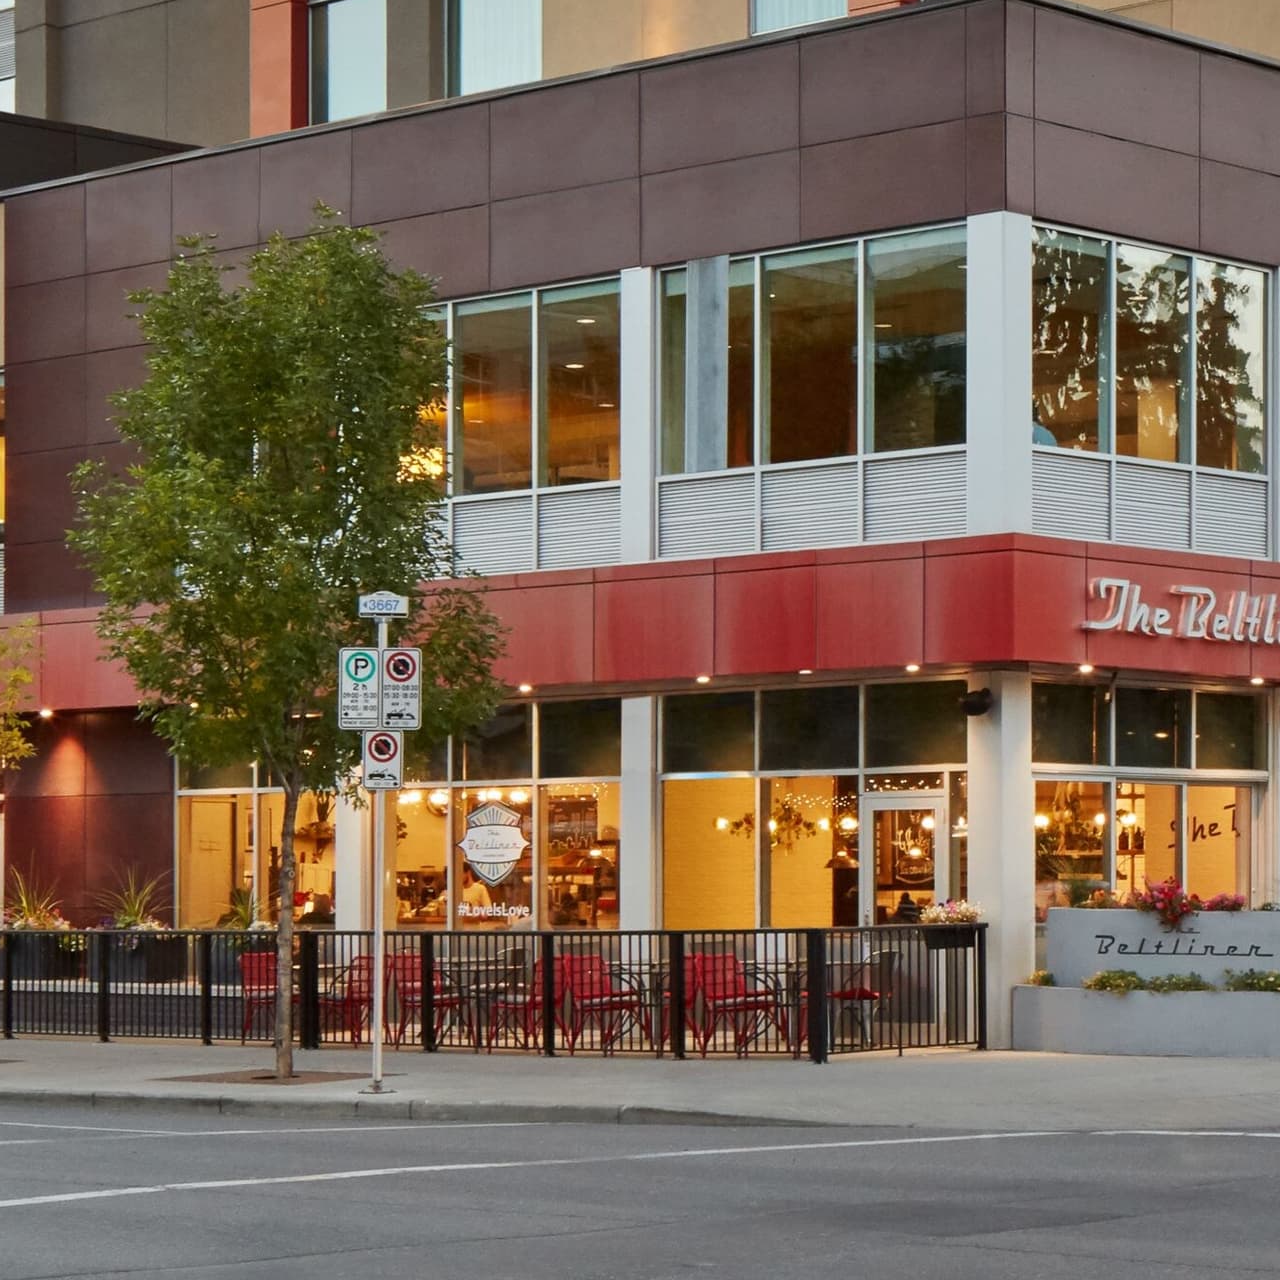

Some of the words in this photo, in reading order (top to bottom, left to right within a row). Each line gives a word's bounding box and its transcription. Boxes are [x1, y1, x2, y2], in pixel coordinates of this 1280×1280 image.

[368, 599, 400, 612] 3667
[1083, 577, 1173, 636] The
[1095, 934, 1274, 958] Beltliner
